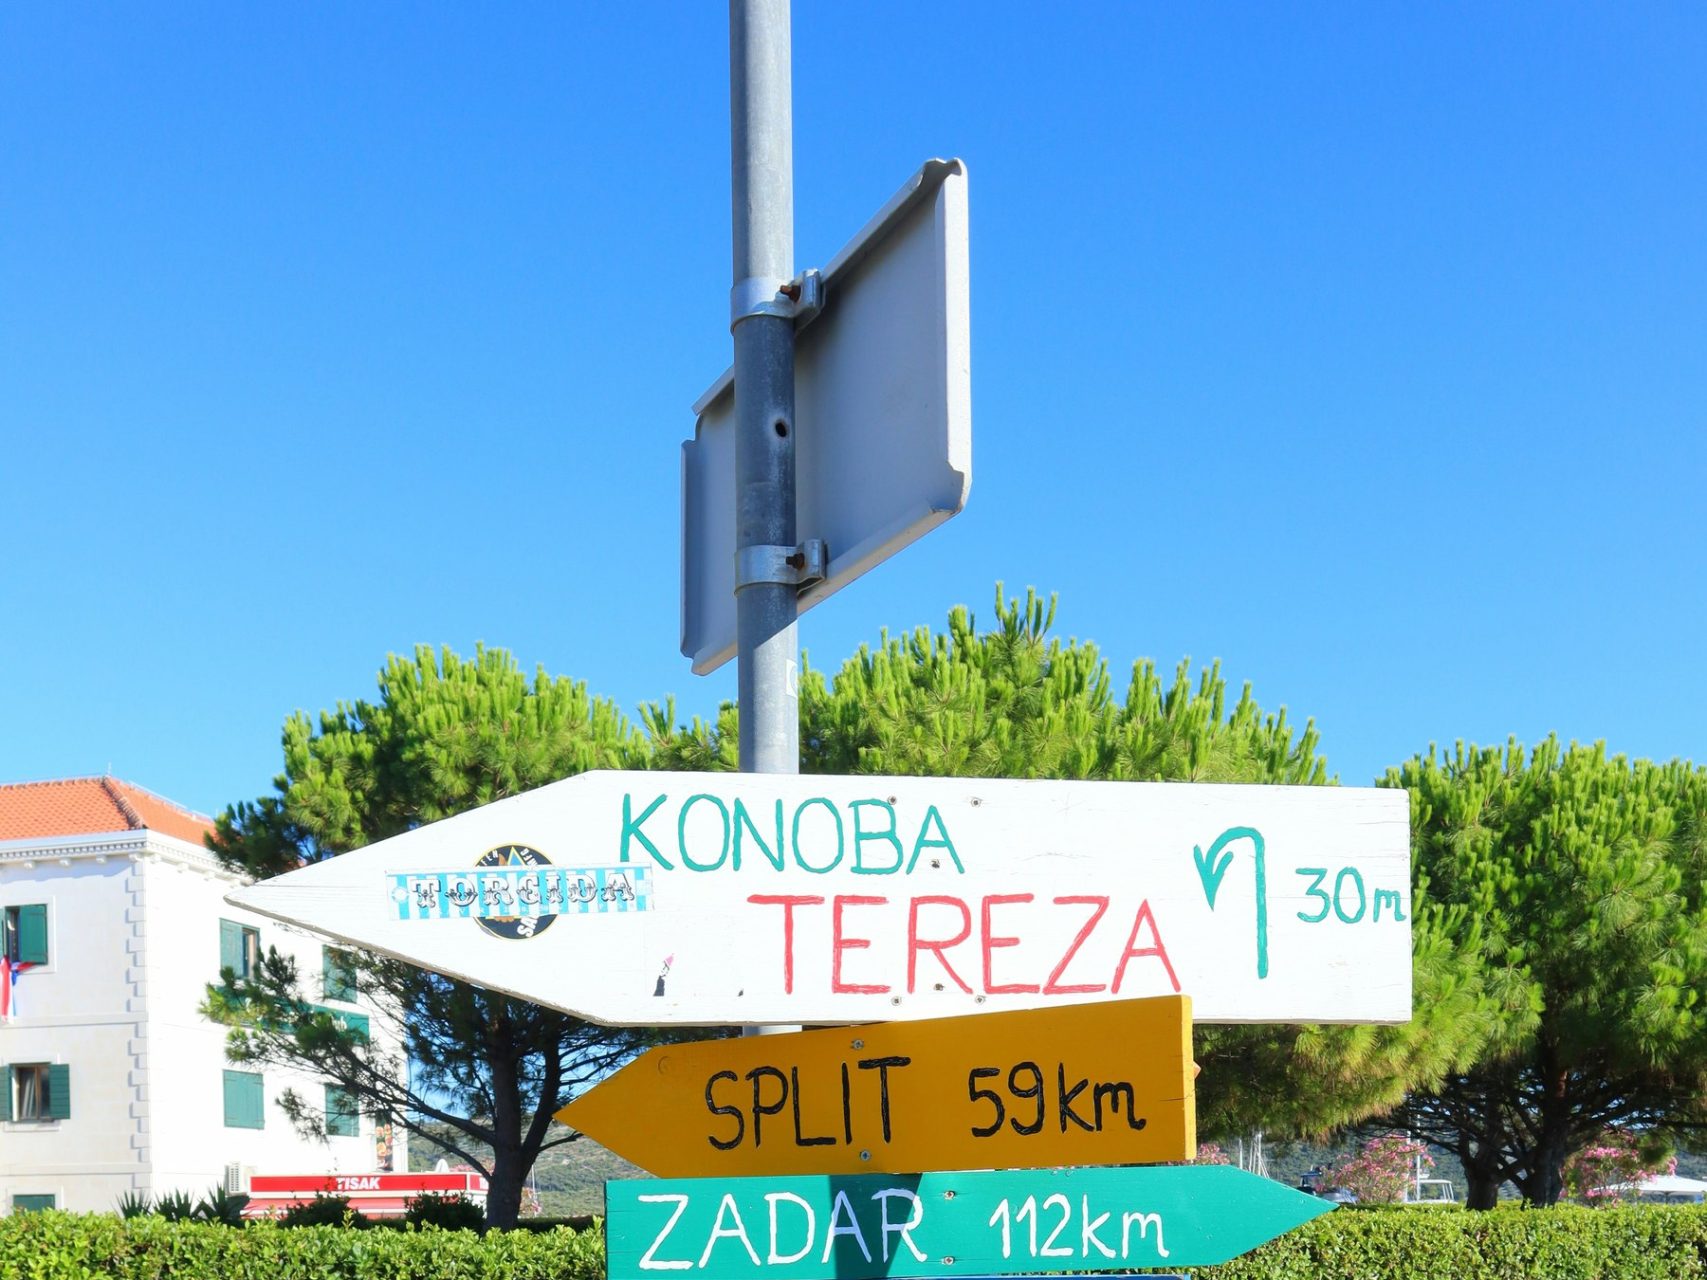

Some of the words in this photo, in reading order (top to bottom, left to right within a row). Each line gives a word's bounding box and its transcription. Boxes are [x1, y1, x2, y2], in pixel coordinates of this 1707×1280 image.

[620, 792, 965, 875] KONOBA
[747, 892, 1182, 996] TEREZA
[703, 1055, 912, 1152] SPLIT
[335, 1177, 380, 1190] TISAK
[637, 1190, 928, 1271] ZADAR
